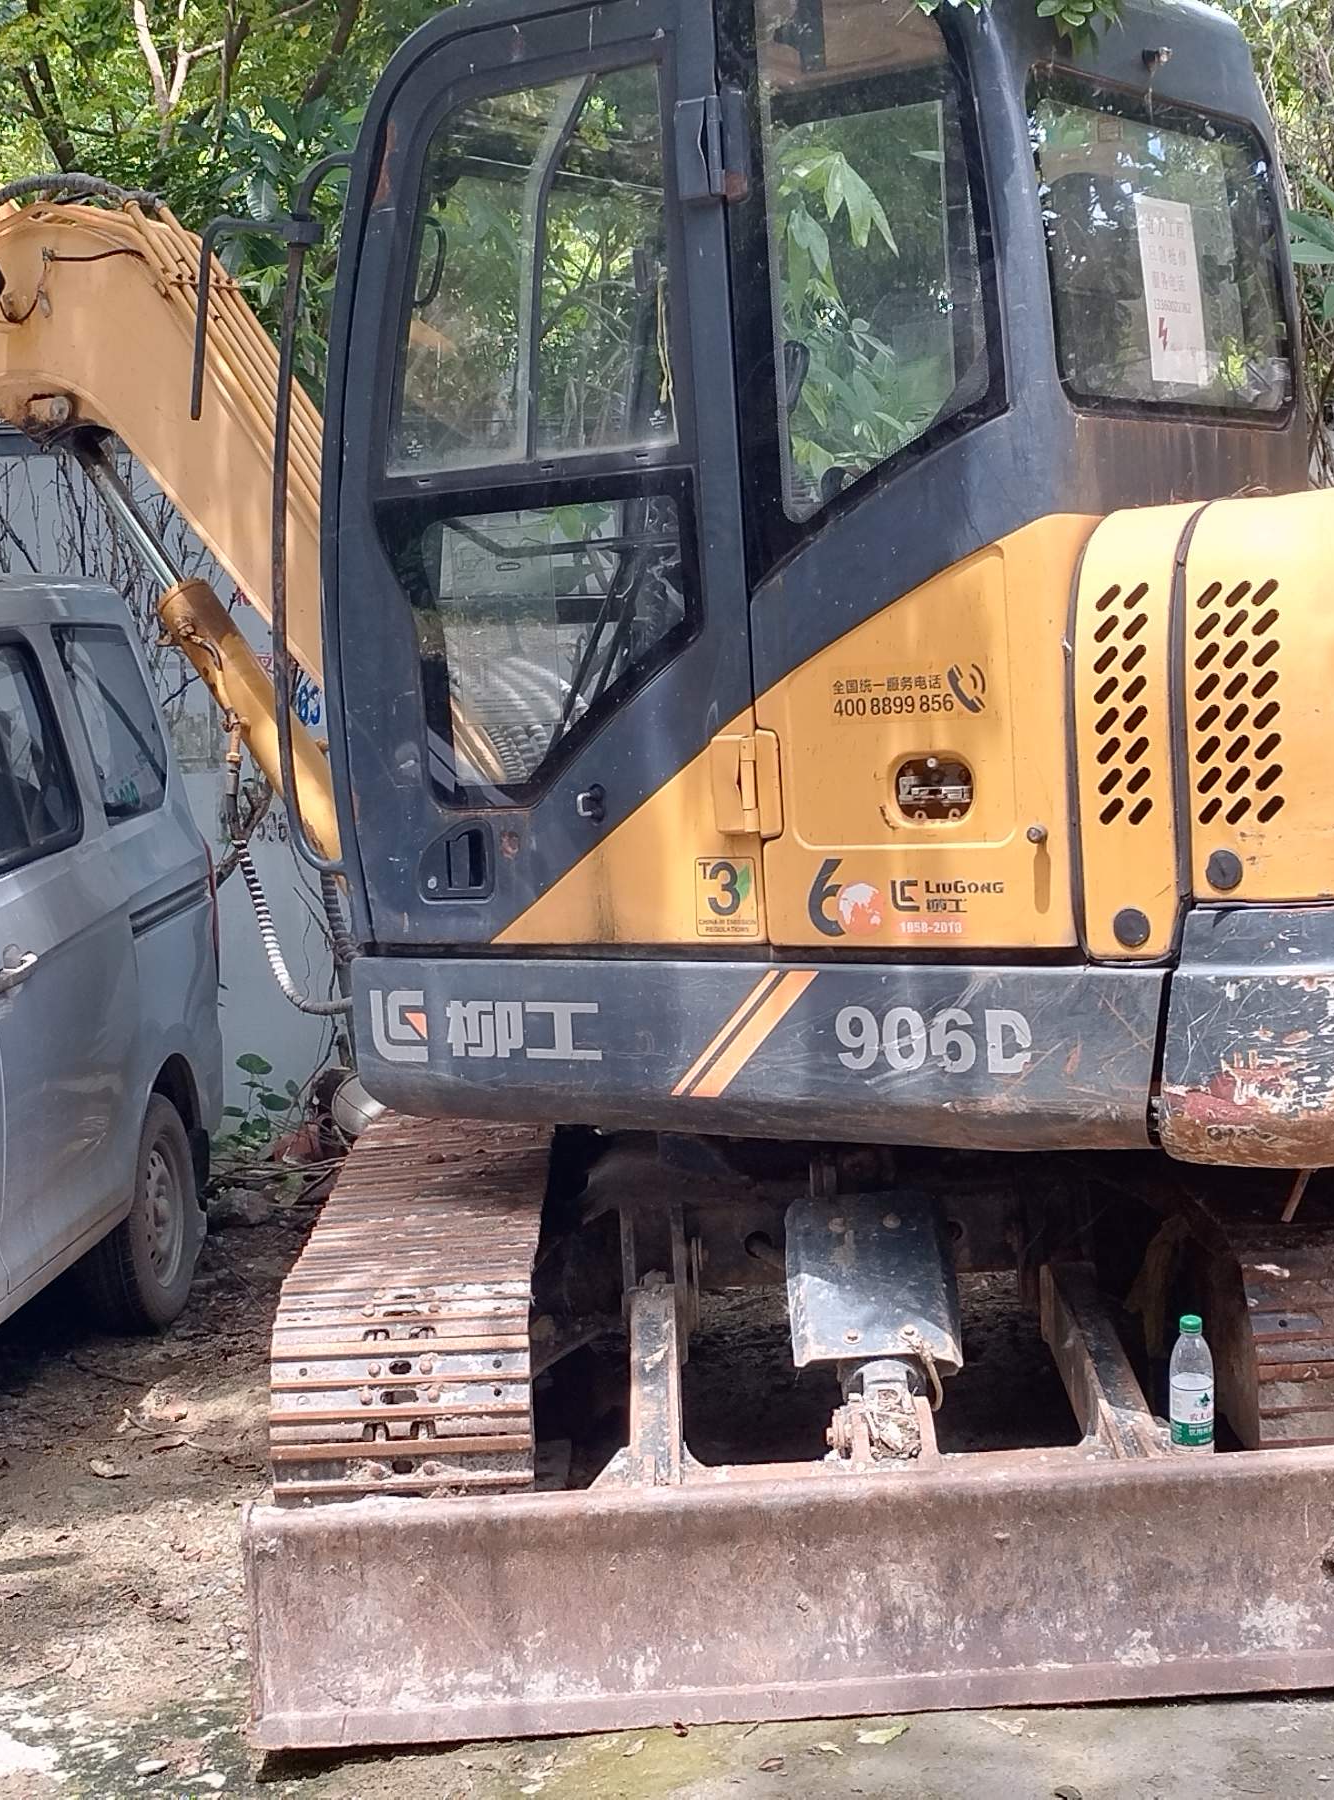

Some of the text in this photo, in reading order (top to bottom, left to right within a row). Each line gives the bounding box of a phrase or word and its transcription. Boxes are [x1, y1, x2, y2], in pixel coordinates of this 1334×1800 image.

[833, 674, 942, 695] 全国统一服务电话
[833, 693, 955, 717] 400 8899 856
[898, 921, 963, 934] 1958-2018
[445, 1000, 603, 1061] 柳工
[835, 1005, 1033, 1074] 906D
